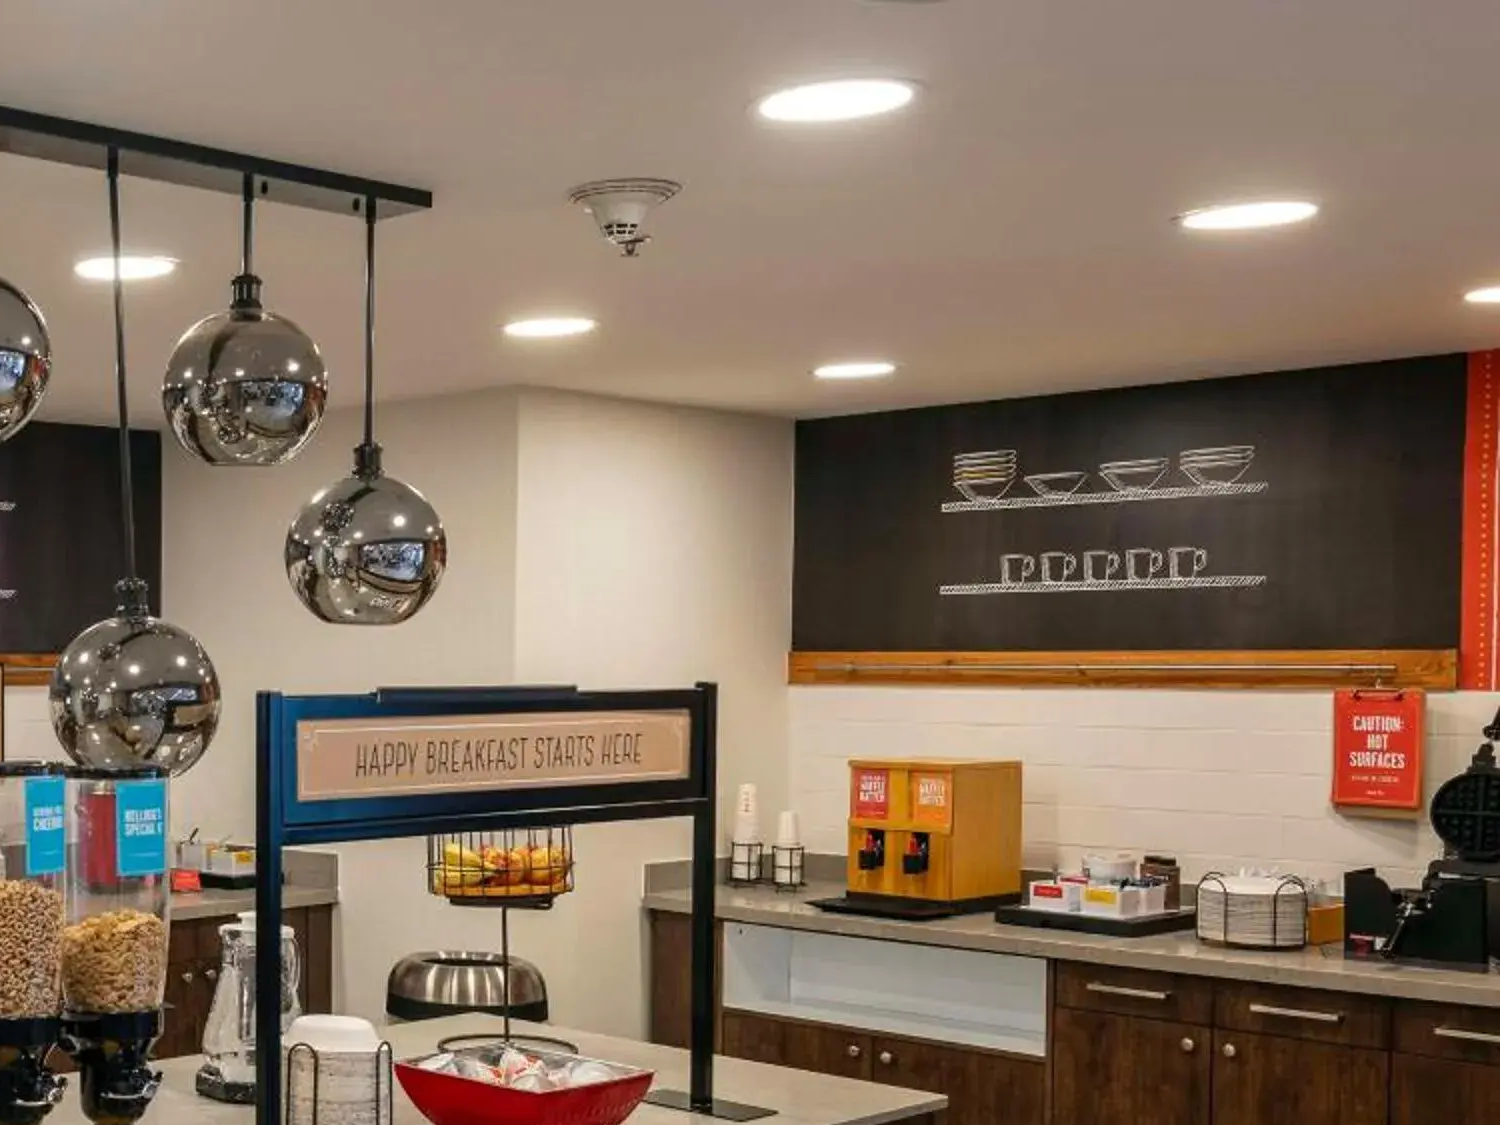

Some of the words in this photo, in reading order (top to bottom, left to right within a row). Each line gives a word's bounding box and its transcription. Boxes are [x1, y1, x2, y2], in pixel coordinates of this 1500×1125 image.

[1353, 715, 1405, 732] CAUTION:
[1367, 733, 1389, 750] HOT
[356, 742, 419, 778] HAPPY
[425, 737, 528, 775] BREAKFAST
[534, 735, 595, 769] STARTS
[601, 733, 643, 766] HERE
[1349, 752, 1405, 769] SURFACES
